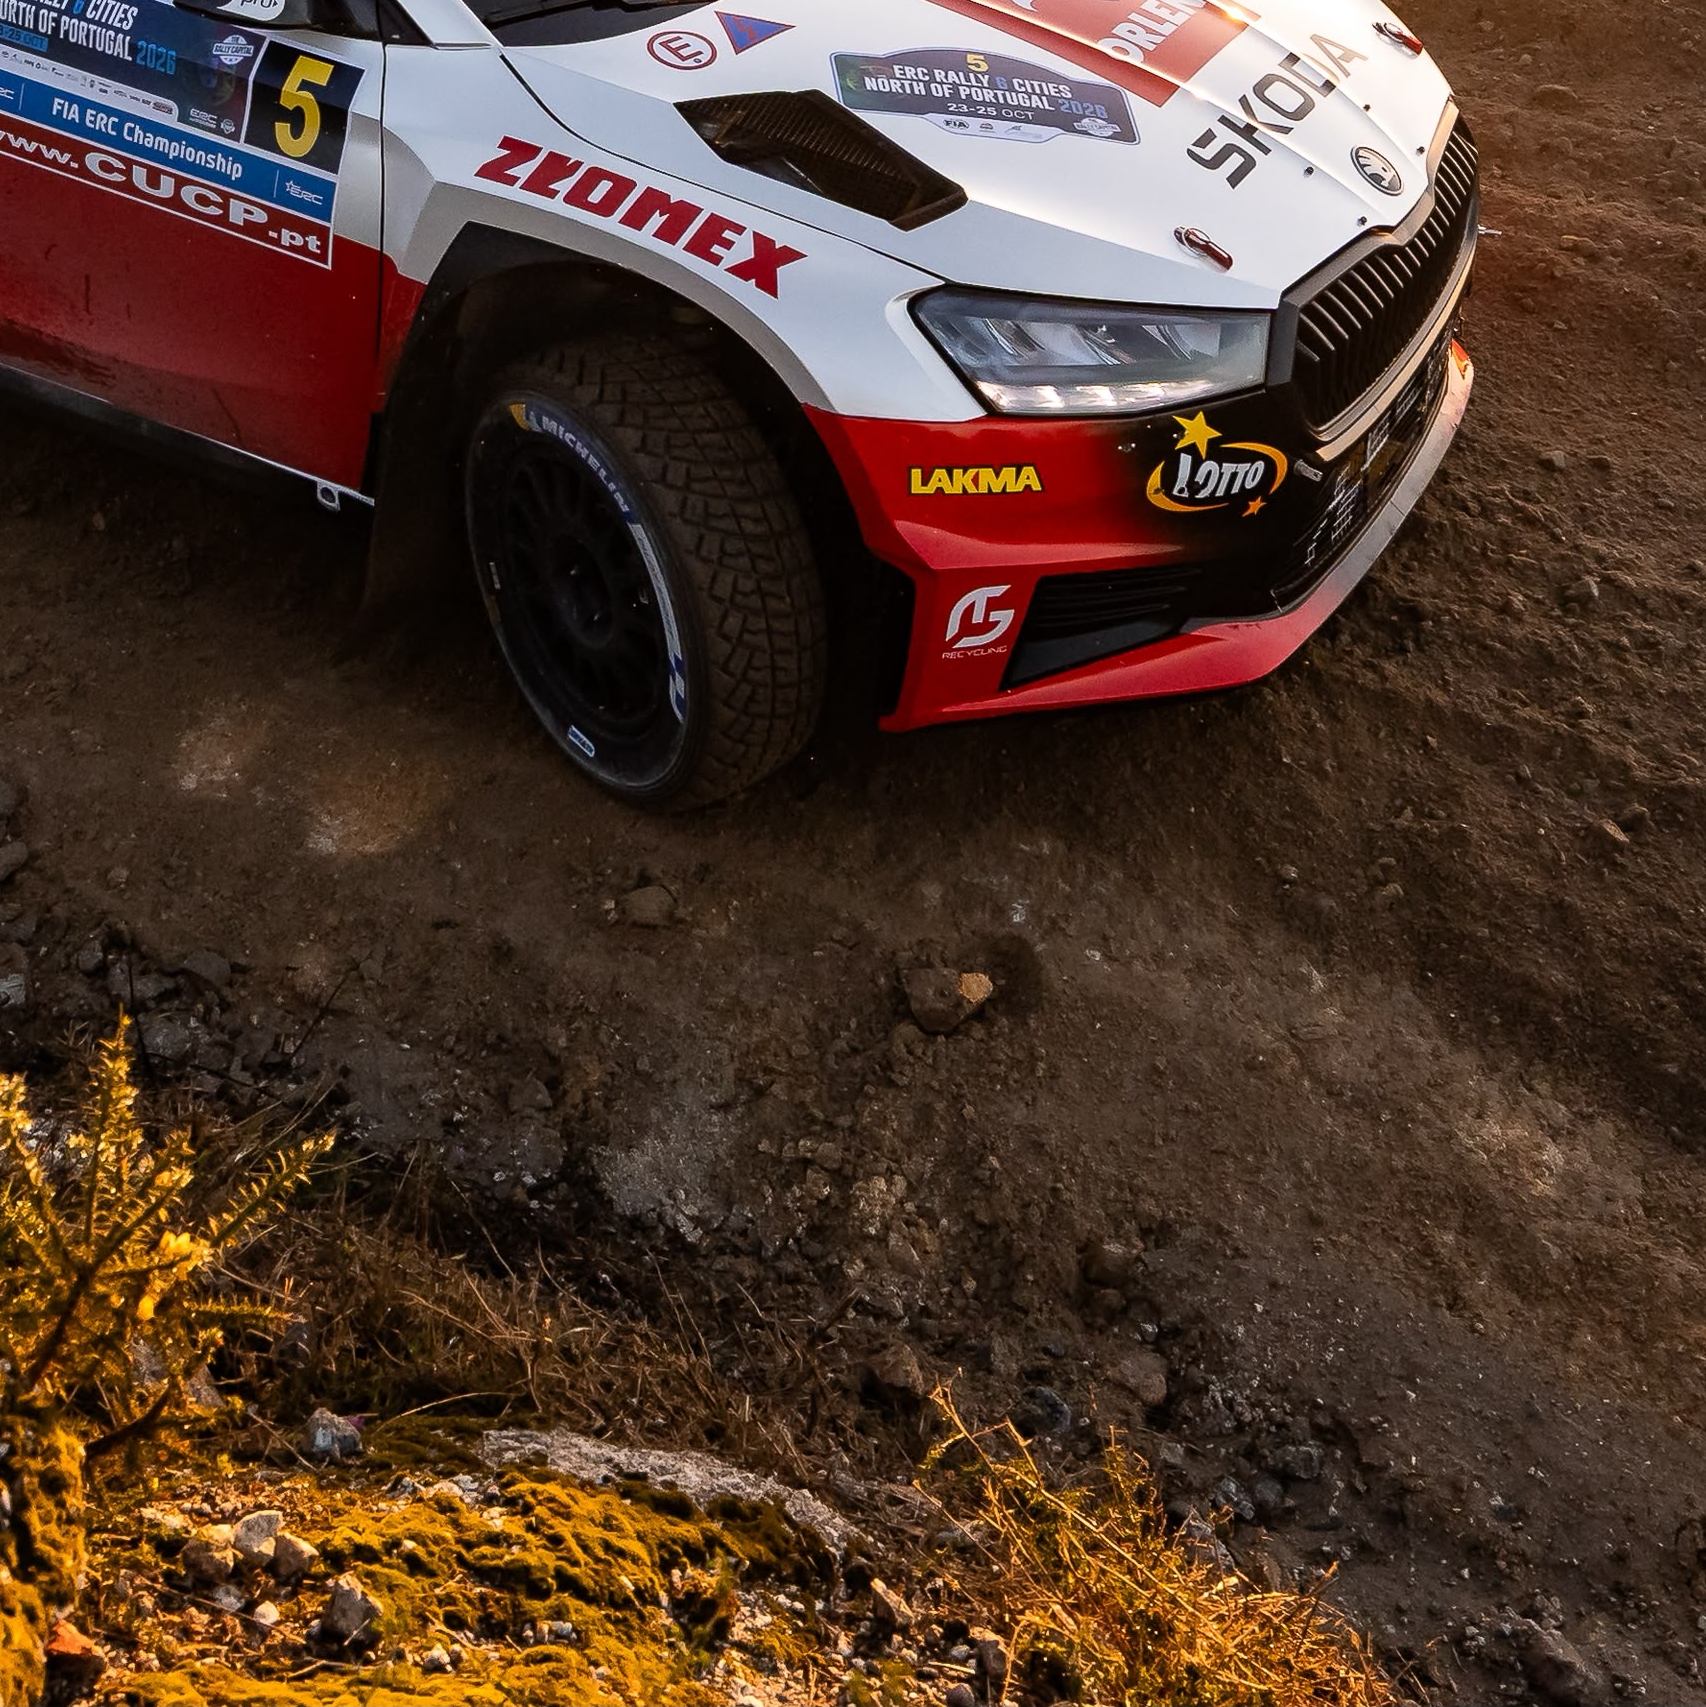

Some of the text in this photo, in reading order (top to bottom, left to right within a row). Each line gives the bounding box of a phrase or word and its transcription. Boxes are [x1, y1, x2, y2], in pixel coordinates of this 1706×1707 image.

[38, 6, 56, 36] OF
[59, 14, 133, 61] PORTUGAL
[136, 40, 178, 75] 2026
[966, 53, 990, 72] 5
[864, 76, 926, 96] NORTH
[930, 82, 953, 98] OF
[958, 85, 1055, 110] PORTUGAL
[893, 64, 1072, 98] ERC RALLY 6 CITIES
[275, 55, 334, 157] 5
[947, 102, 1035, 121] 23-25 OCT
[52, 97, 79, 124] FIA
[85, 108, 116, 136] ERC
[123, 121, 242, 180] Championship
[542, 414, 630, 512] MICHELIN
[910, 465, 1042, 495] LAKMA
[1173, 453, 1265, 499] LOTTO
[942, 645, 1007, 659] RECYCLING
